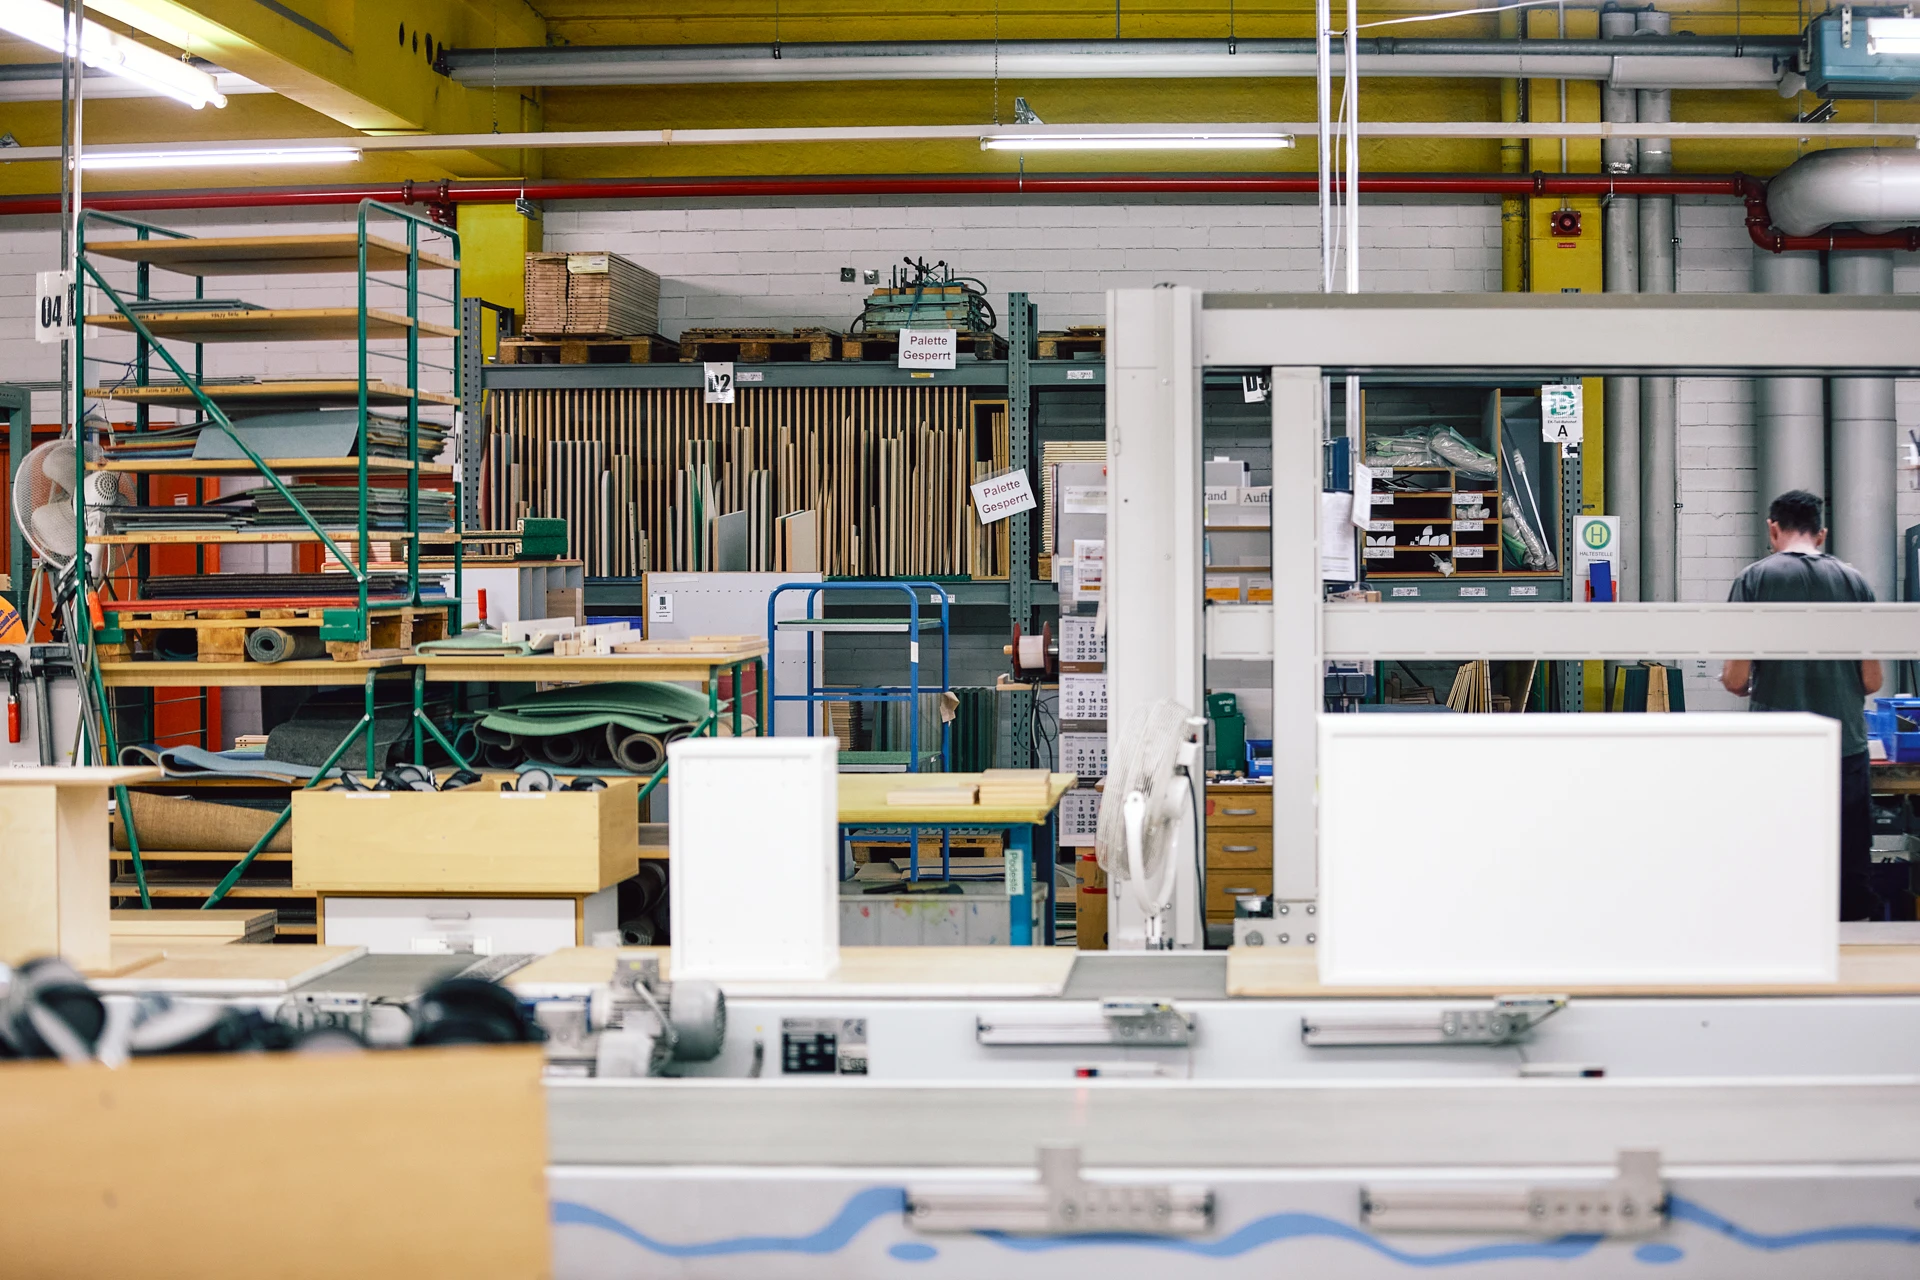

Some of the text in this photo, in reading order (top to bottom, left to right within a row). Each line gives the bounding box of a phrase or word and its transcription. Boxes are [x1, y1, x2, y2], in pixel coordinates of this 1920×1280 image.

[910, 335, 948, 346] Palette
[903, 350, 951, 362] Gesperrt
[1557, 424, 1568, 437] A
[983, 480, 1021, 498] Palette
[1205, 490, 1227, 501] and
[982, 492, 1029, 514] Gesperrt
[1591, 526, 1603, 543] H
